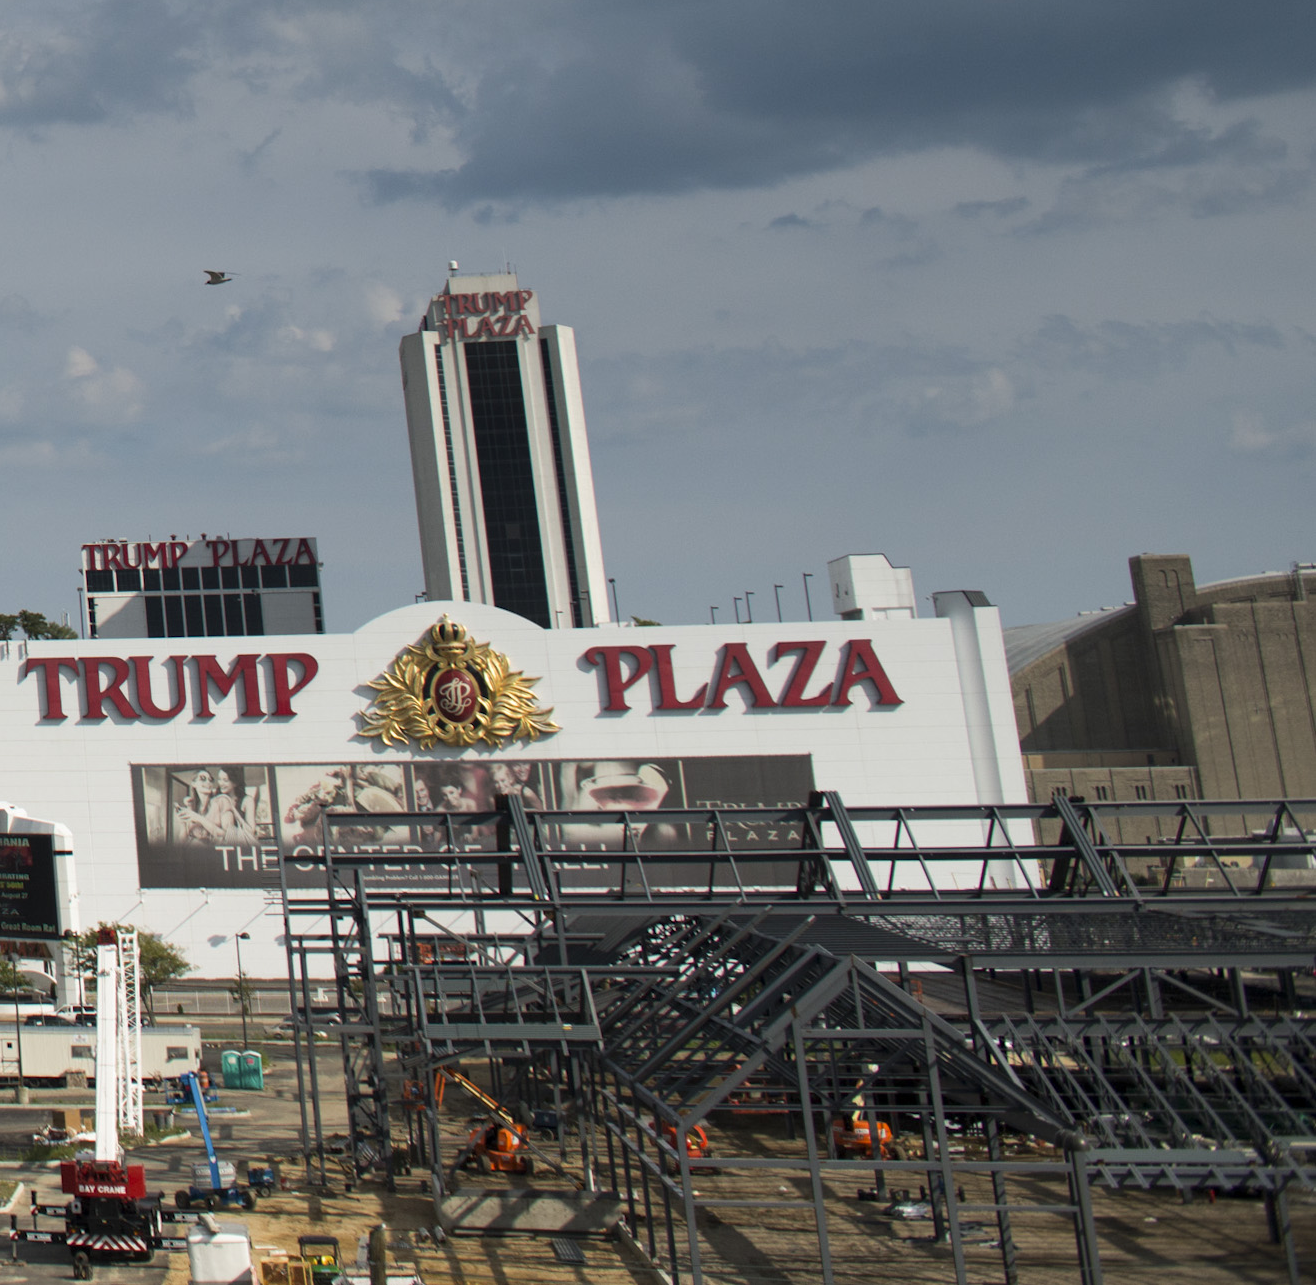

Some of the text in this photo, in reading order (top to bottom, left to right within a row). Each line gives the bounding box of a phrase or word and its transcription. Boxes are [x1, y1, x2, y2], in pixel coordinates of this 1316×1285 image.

[438, 290, 533, 314] TRUMP
[441, 314, 536, 338] PLAZA
[81, 538, 317, 570] TRUMP PLAZA
[25, 639, 905, 719] TRUMP PLAZA
[215, 846, 280, 871] THE
[0, 921, 20, 930] Great
[21, 923, 42, 932] Room
[78, 1185, 127, 1194] BAY CRANE
